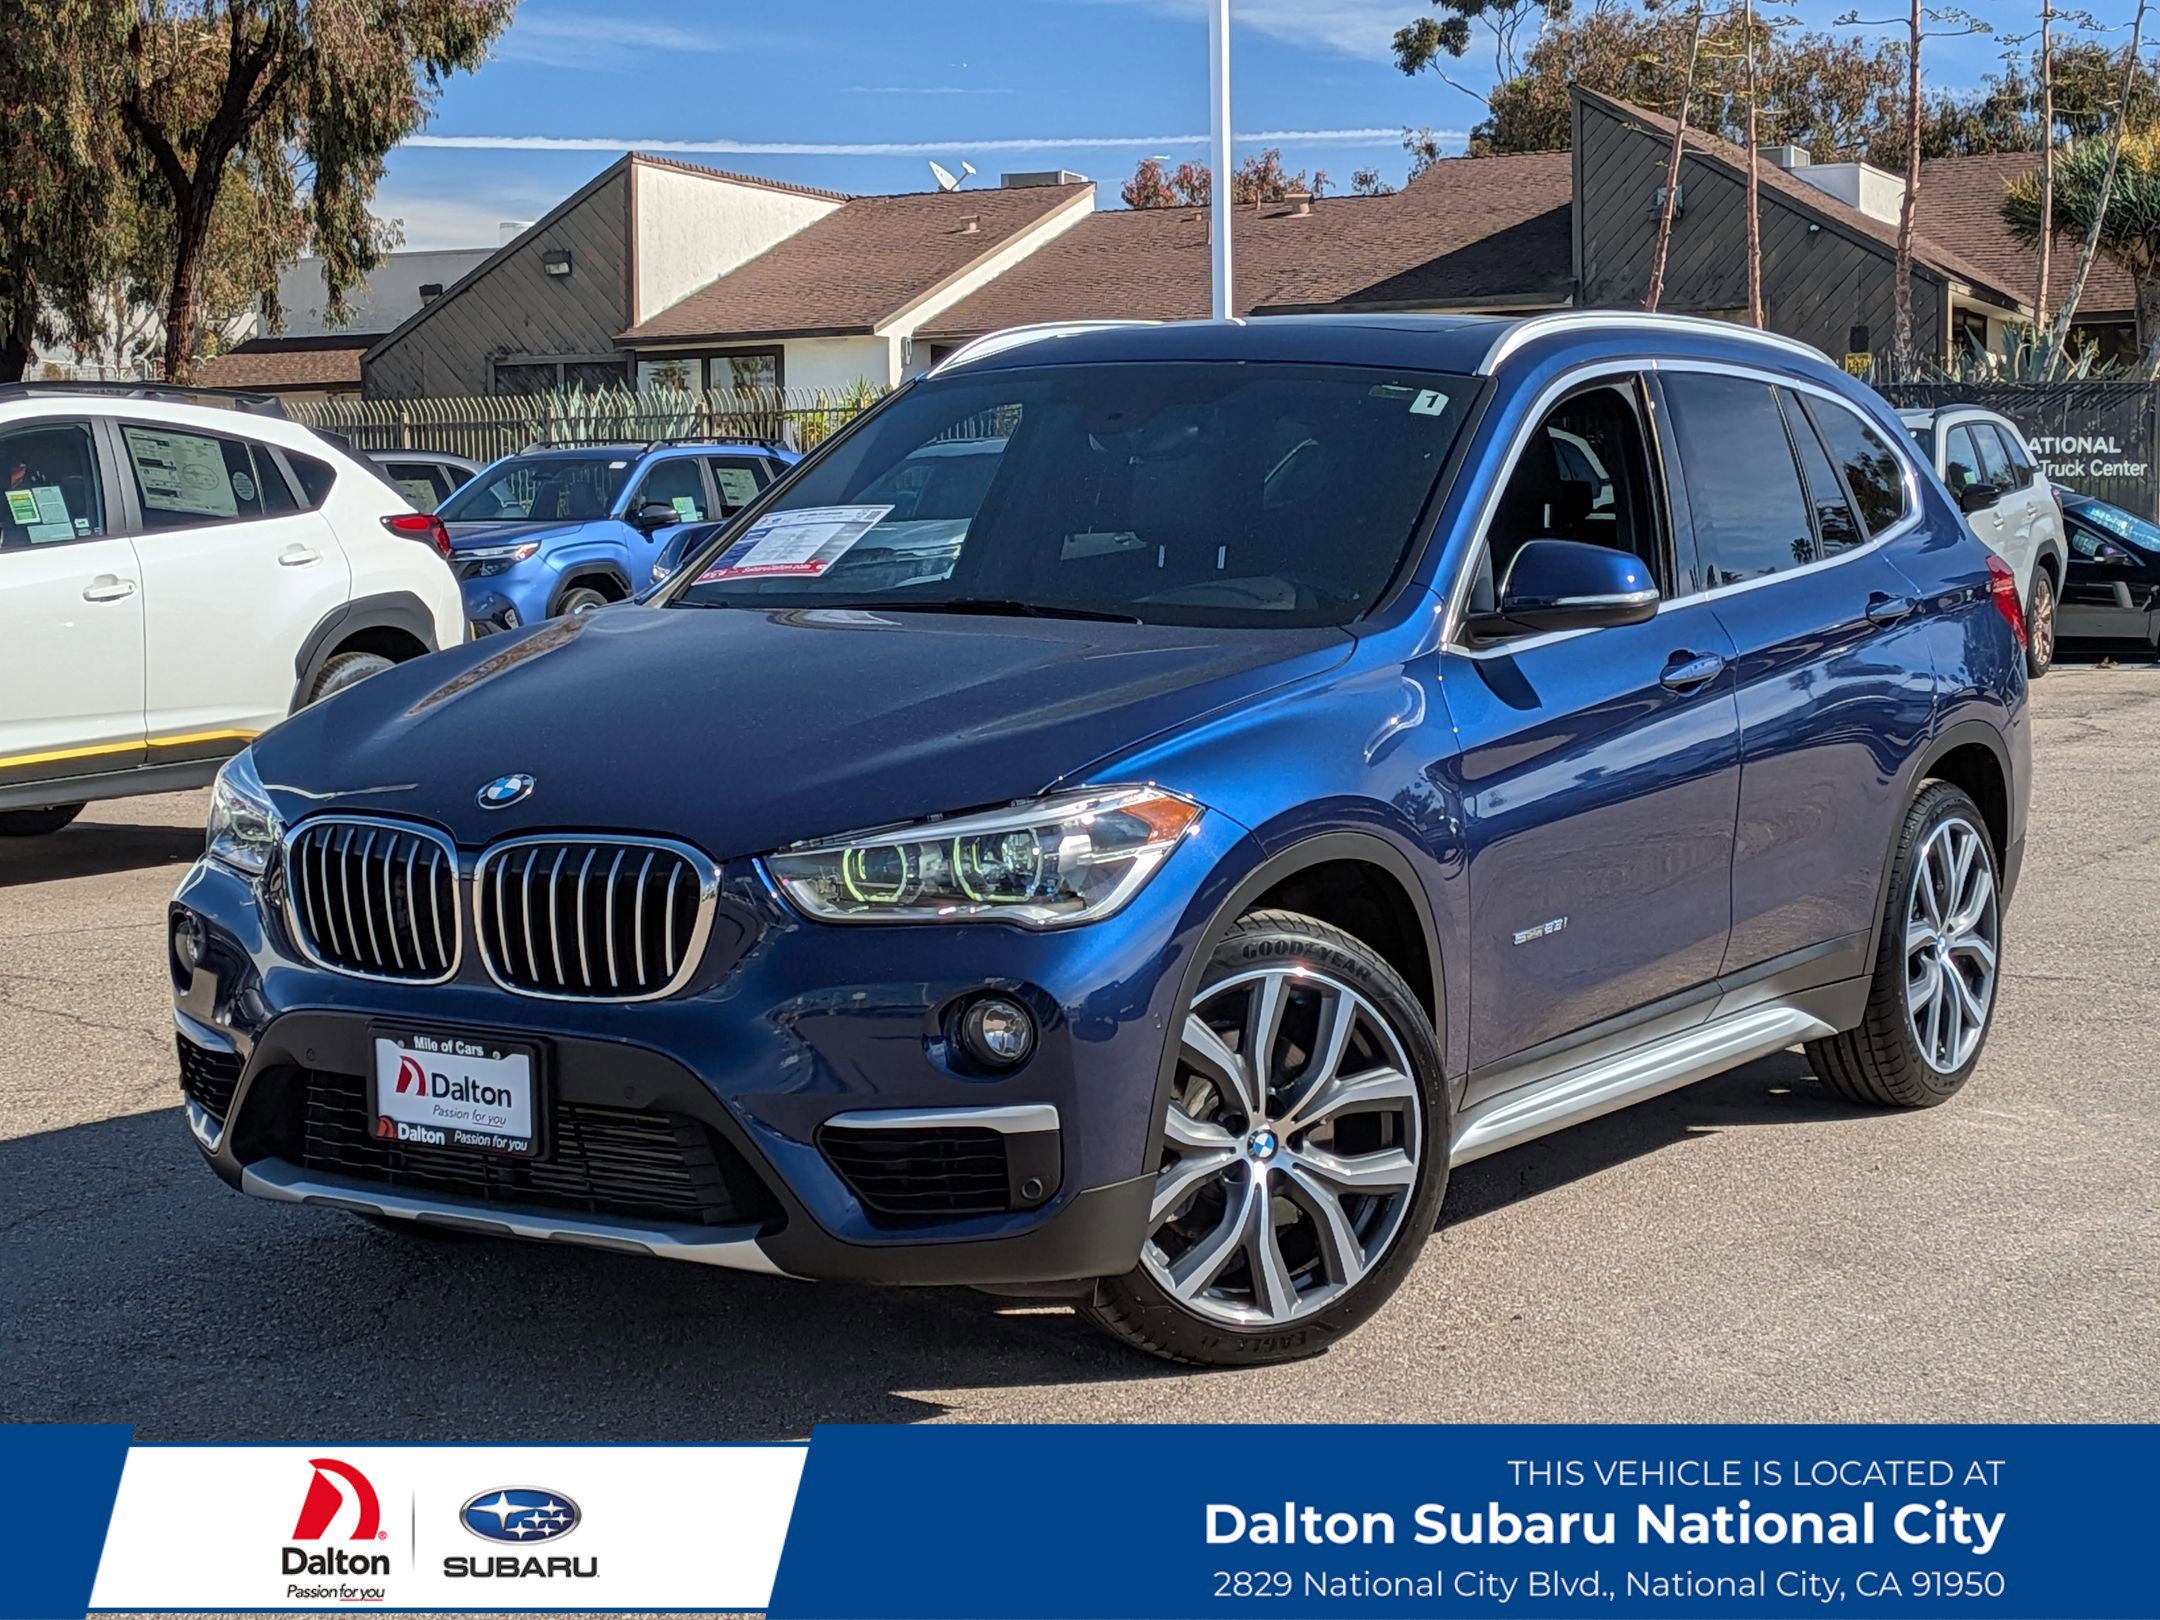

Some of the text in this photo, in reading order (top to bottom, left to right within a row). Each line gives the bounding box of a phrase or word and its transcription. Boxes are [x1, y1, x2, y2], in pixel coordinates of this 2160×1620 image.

[1426, 394, 1439, 408] 1
[2039, 459, 2148, 477] Truck Center
[413, 1035, 484, 1057] Mile of Cars
[431, 1072, 512, 1109] Dalton
[433, 1105, 507, 1126] Passion for you
[397, 1122, 446, 1145] Dalton
[454, 1130, 528, 1152] Passion for you
